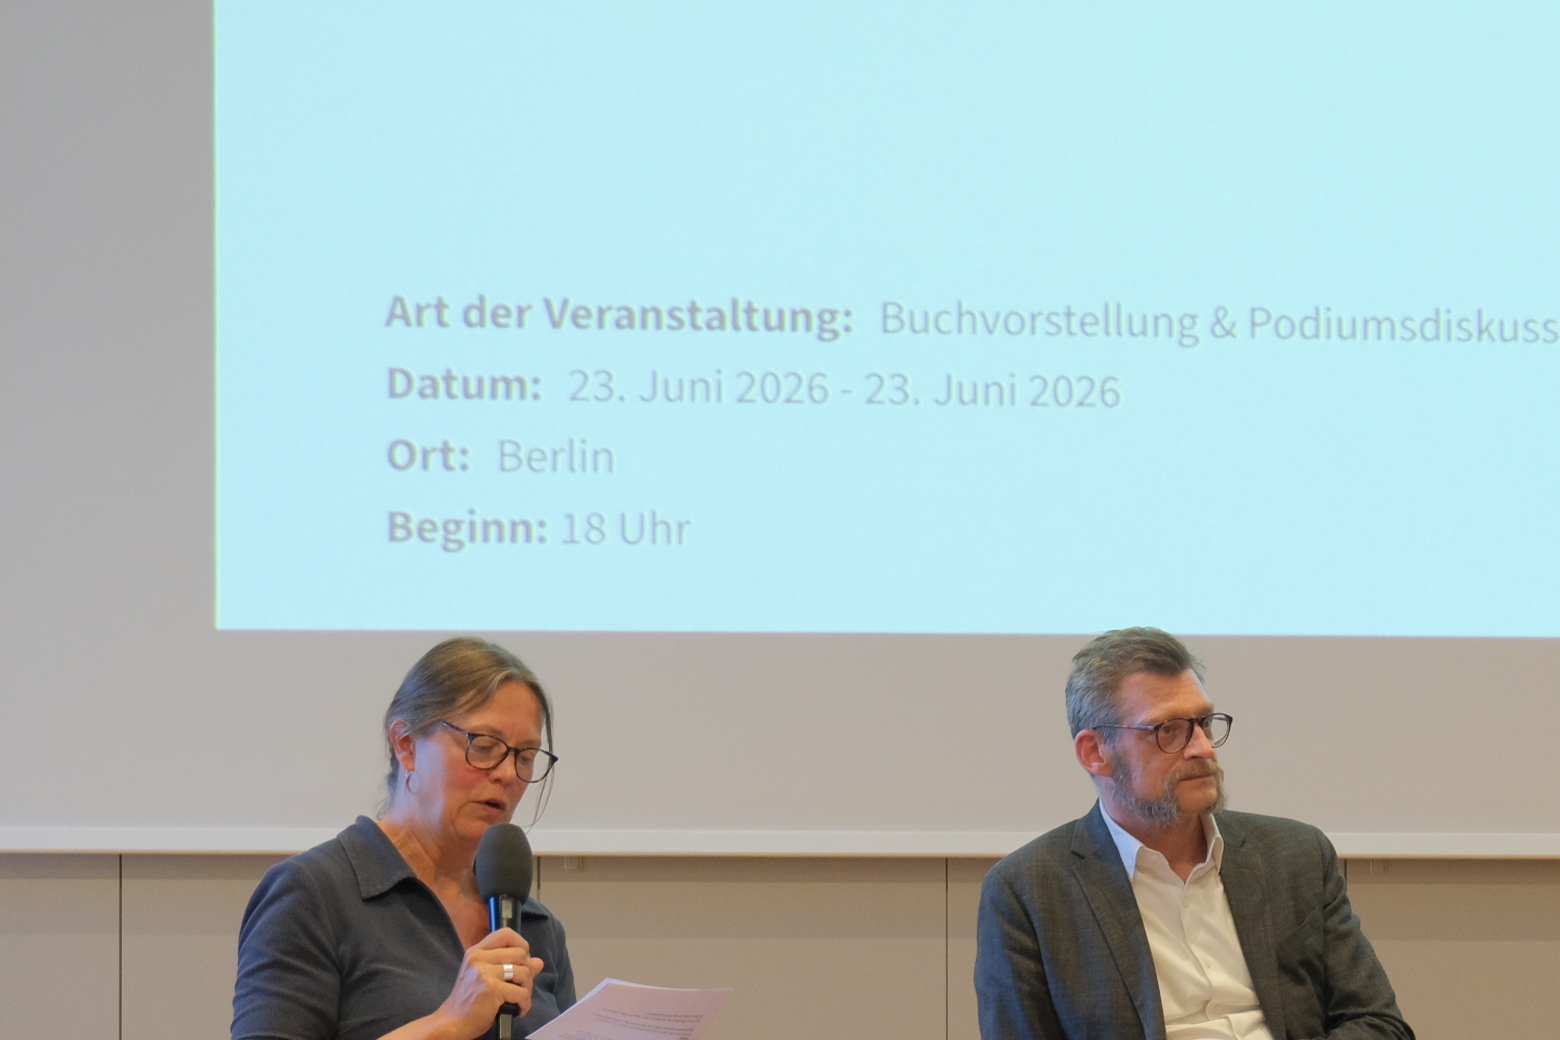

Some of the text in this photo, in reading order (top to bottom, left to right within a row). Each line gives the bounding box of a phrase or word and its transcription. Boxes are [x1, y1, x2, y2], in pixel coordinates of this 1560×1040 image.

[385, 296, 449, 328] Art
[462, 294, 532, 329] der
[543, 297, 852, 342] Veranstaltung:
[882, 300, 1199, 348] Buchvorstellung
[1210, 306, 1236, 338] &
[388, 368, 540, 401] Datum:
[569, 369, 625, 402] 23.
[639, 369, 722, 403] Juni
[736, 371, 828, 404] 2026
[865, 373, 920, 405] 23.
[934, 373, 1017, 407] Juni
[1030, 375, 1120, 408] 2026
[387, 438, 613, 473] Ort: Berlin
[388, 509, 690, 553] Beginn: 18 Uhr
